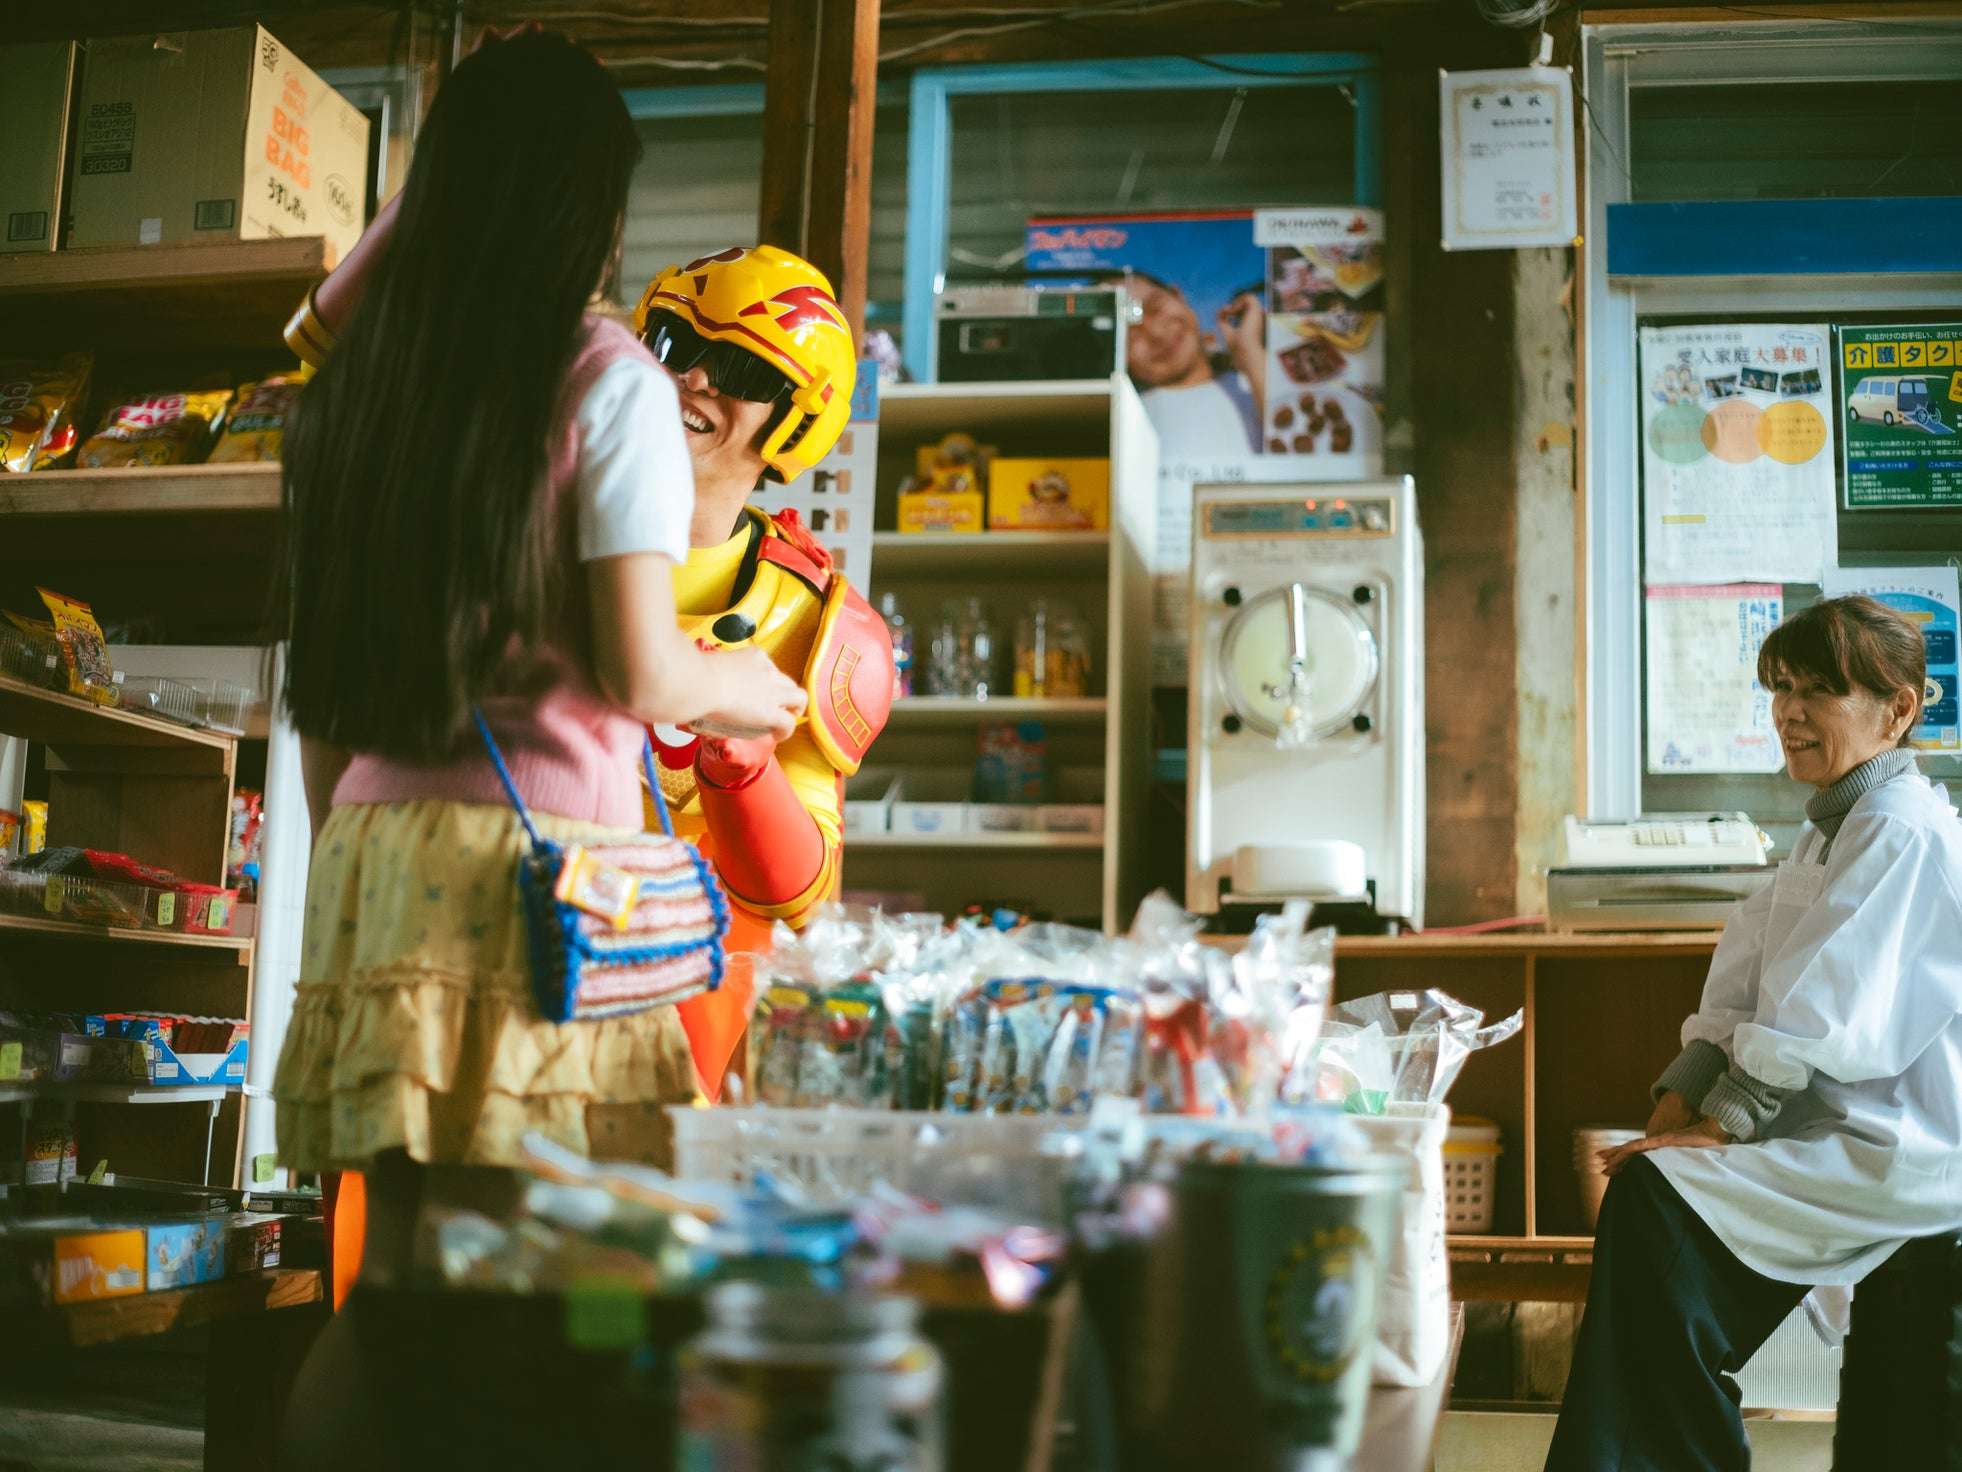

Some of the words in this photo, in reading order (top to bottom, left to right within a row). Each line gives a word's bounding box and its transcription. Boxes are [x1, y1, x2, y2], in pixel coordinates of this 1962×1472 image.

[272, 105, 310, 157] BIG
[264, 133, 311, 191] BAG
[1849, 344, 1962, 365] 介護タク
